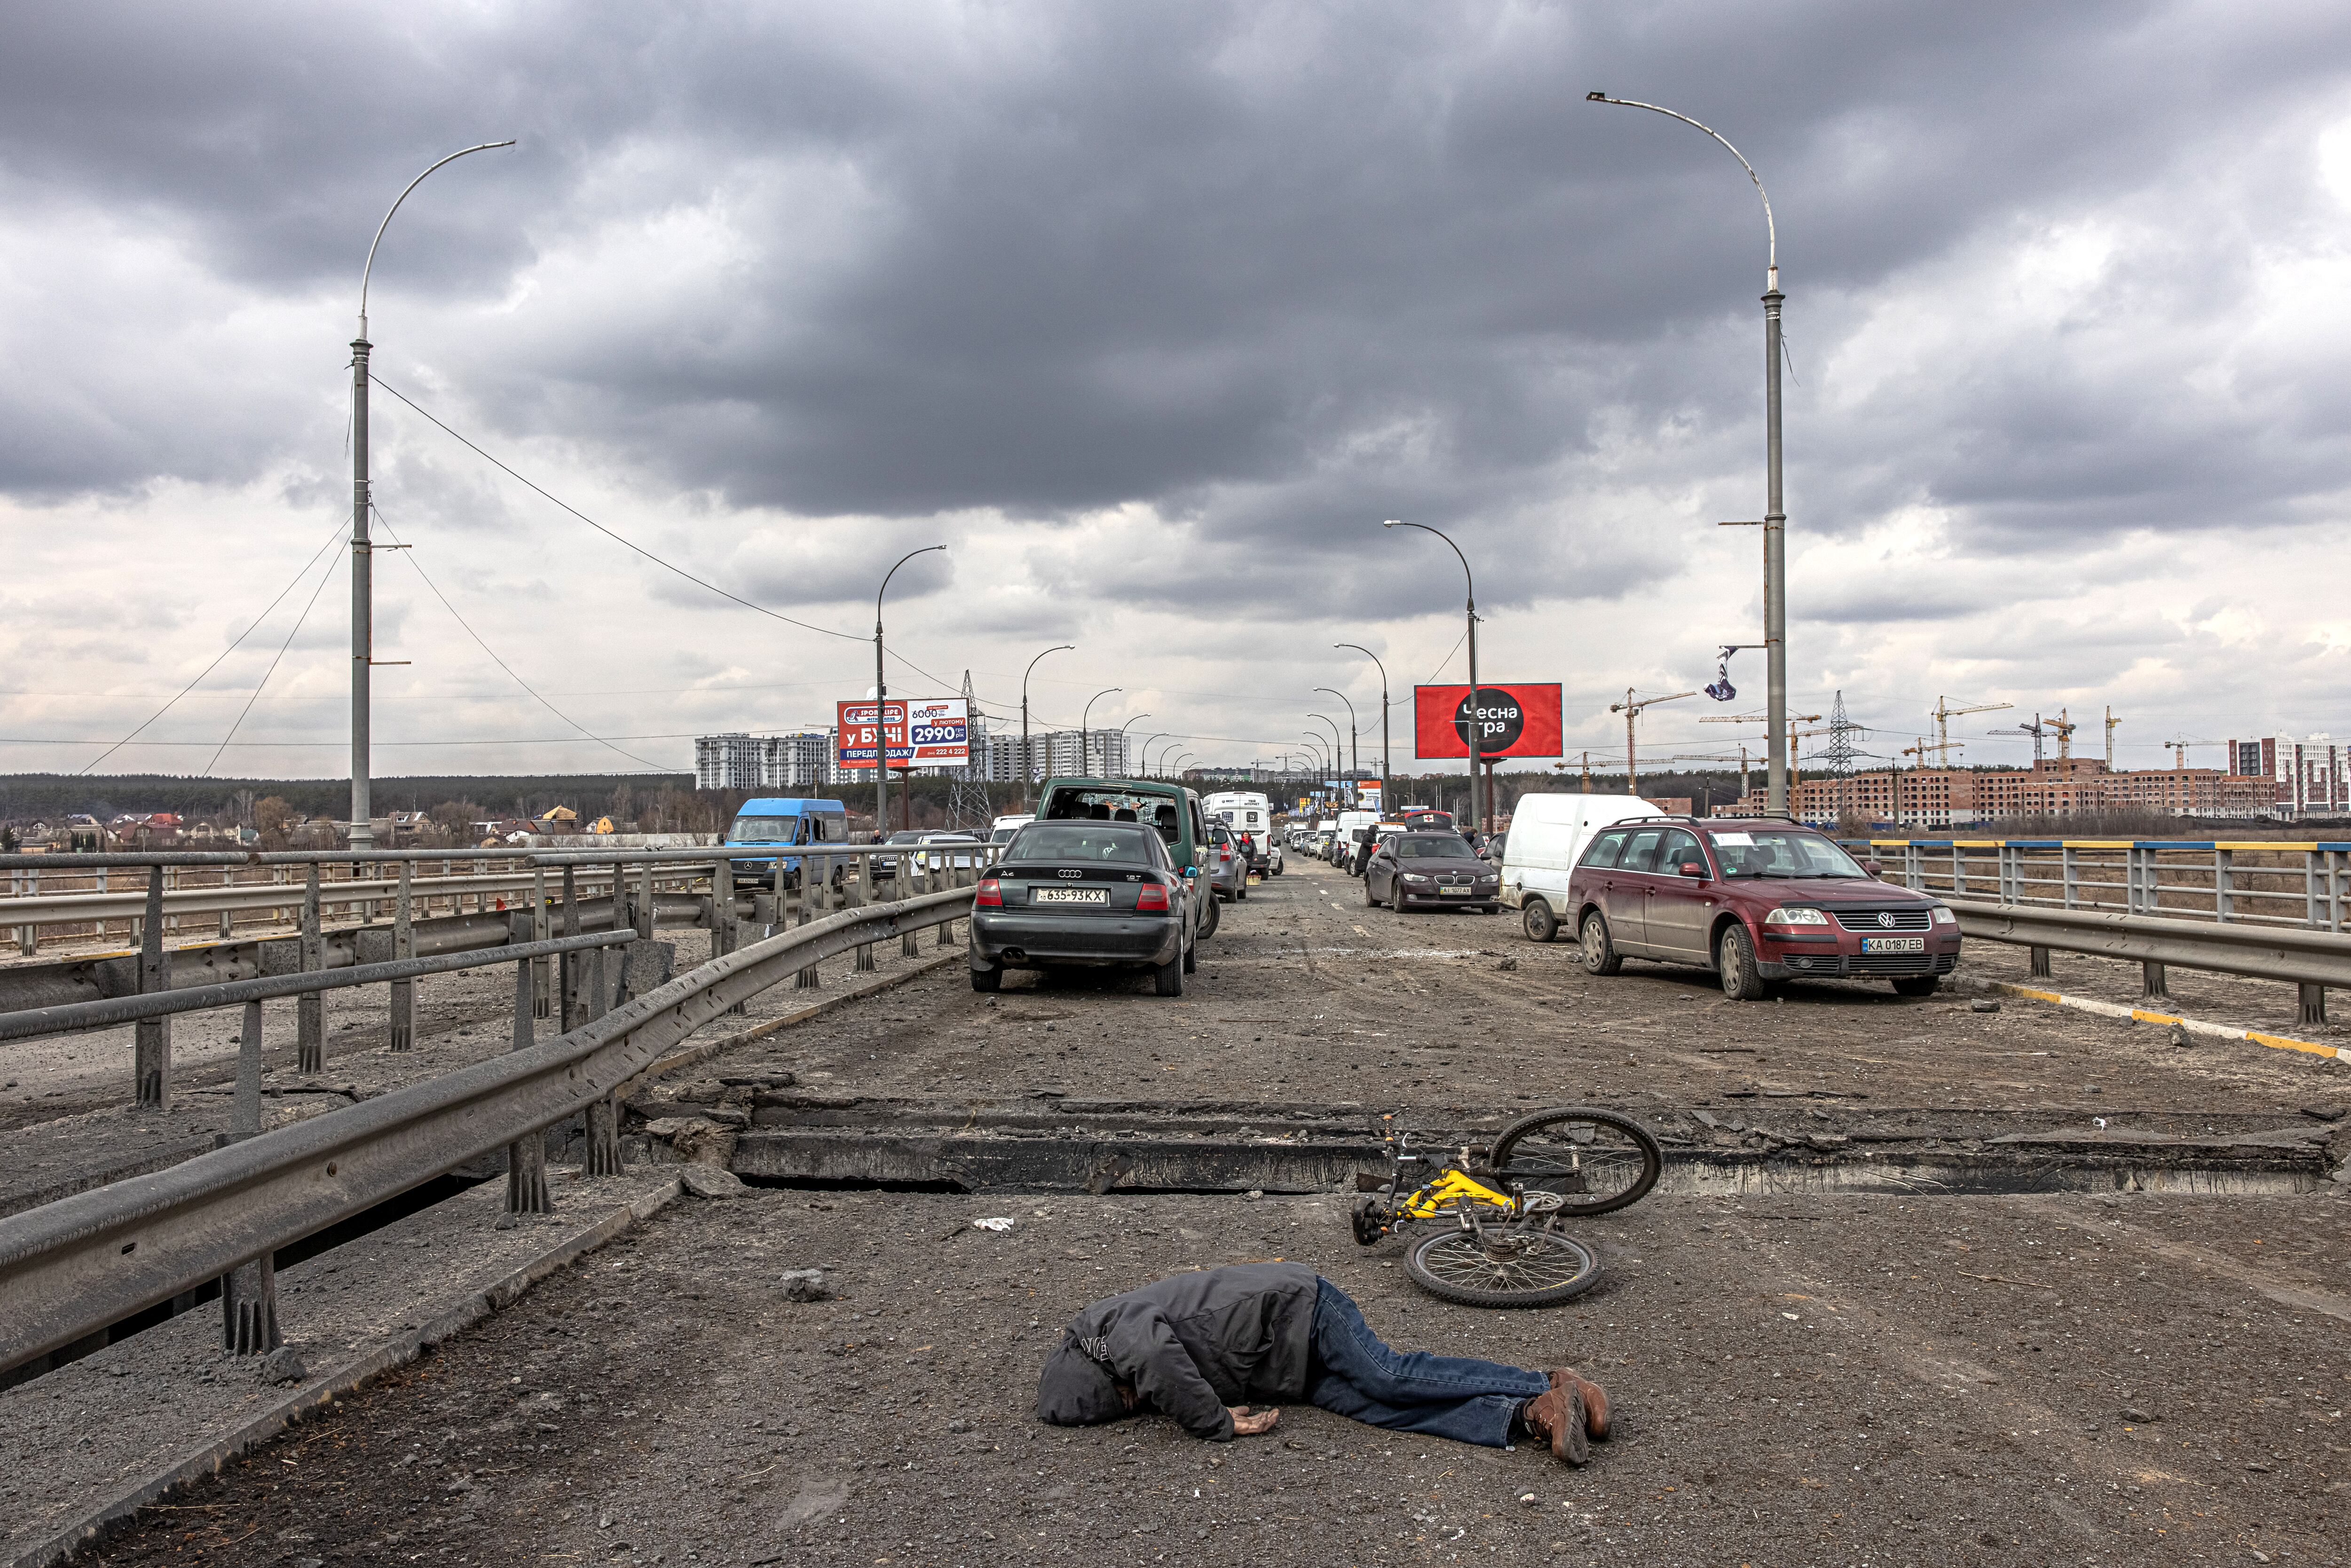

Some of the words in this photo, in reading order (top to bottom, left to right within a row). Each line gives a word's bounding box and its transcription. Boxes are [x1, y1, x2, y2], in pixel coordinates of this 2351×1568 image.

[912, 709, 938, 718] 6000
[915, 726, 955, 742] 2990
[846, 733, 856, 747] у
[846, 749, 912, 758] ПЕРЕДПОДАЖ!
[1868, 940, 1883, 950] KA
[1886, 939, 1907, 950] 0187
[1909, 939, 1922, 949] EB
